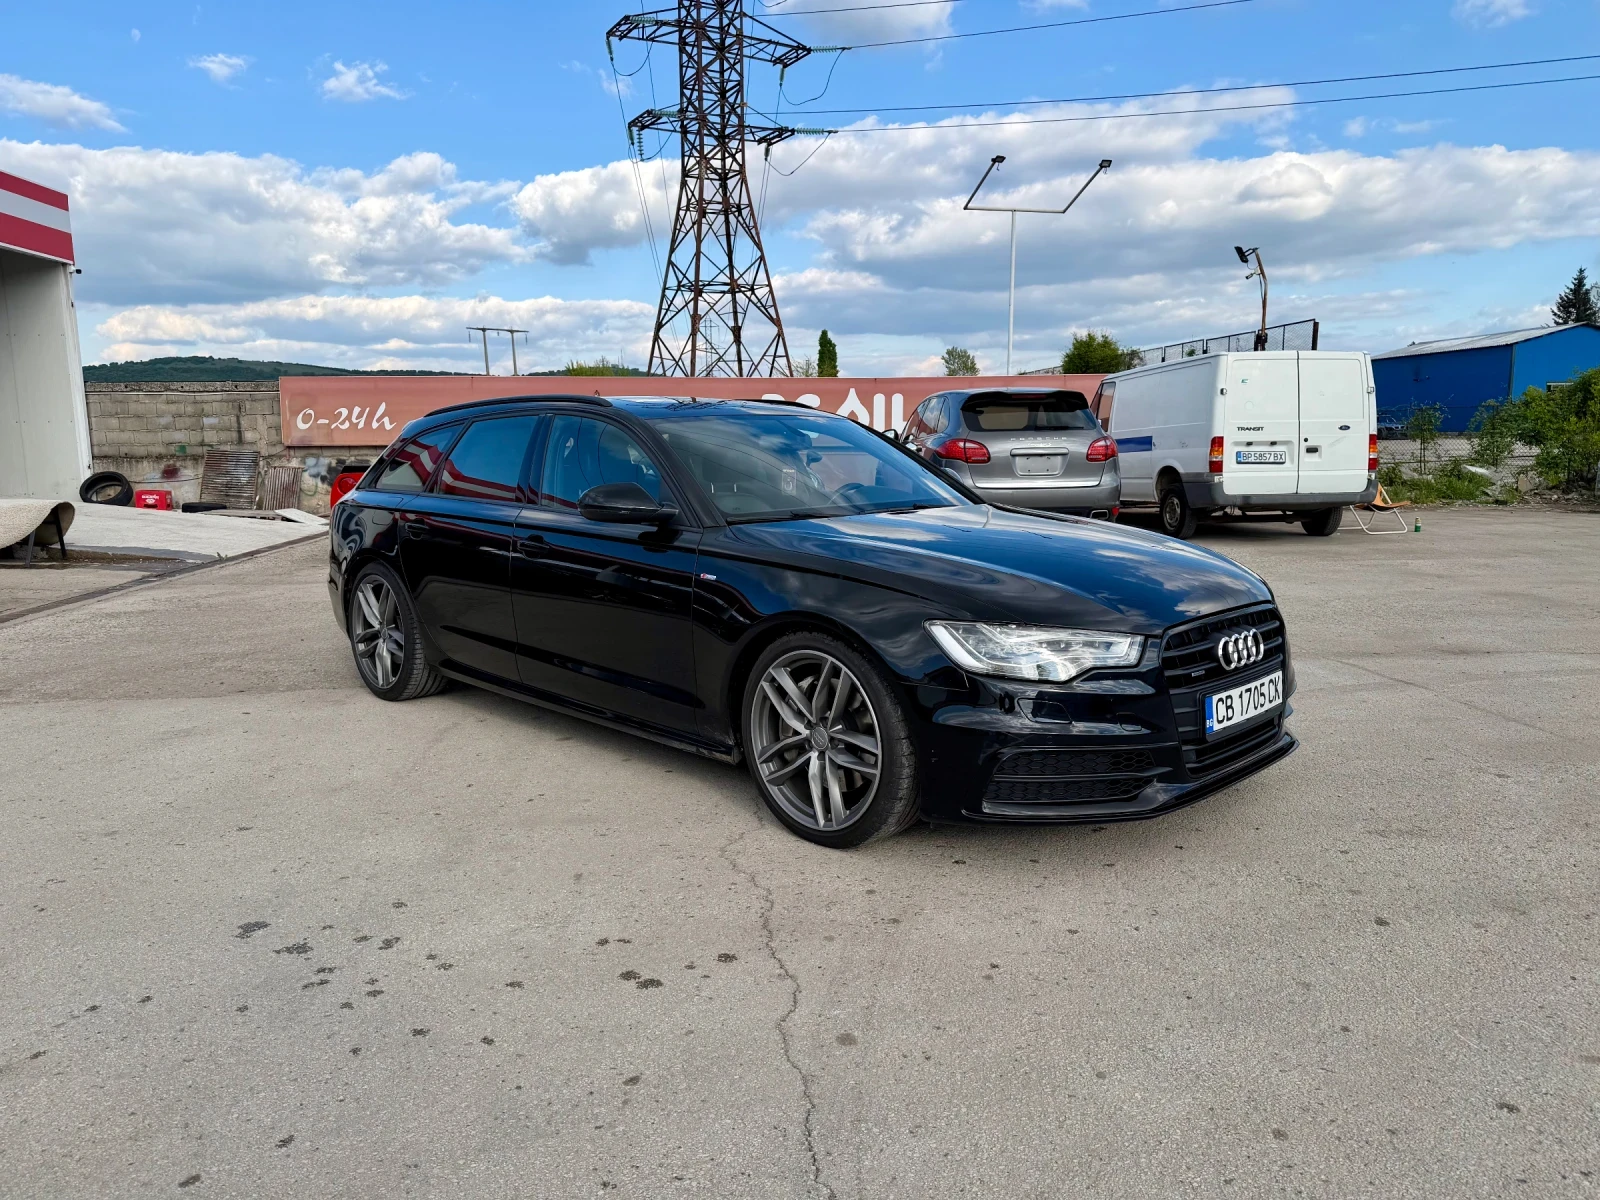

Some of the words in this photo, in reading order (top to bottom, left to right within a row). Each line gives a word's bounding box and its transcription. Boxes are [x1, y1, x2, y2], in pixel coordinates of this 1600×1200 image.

[1242, 452, 1252, 461] BP
[1253, 452, 1272, 461] 5857
[1273, 452, 1284, 461] BX
[1216, 695, 1234, 724] CB
[1239, 683, 1266, 716] 1705
[1268, 676, 1280, 704] CK
